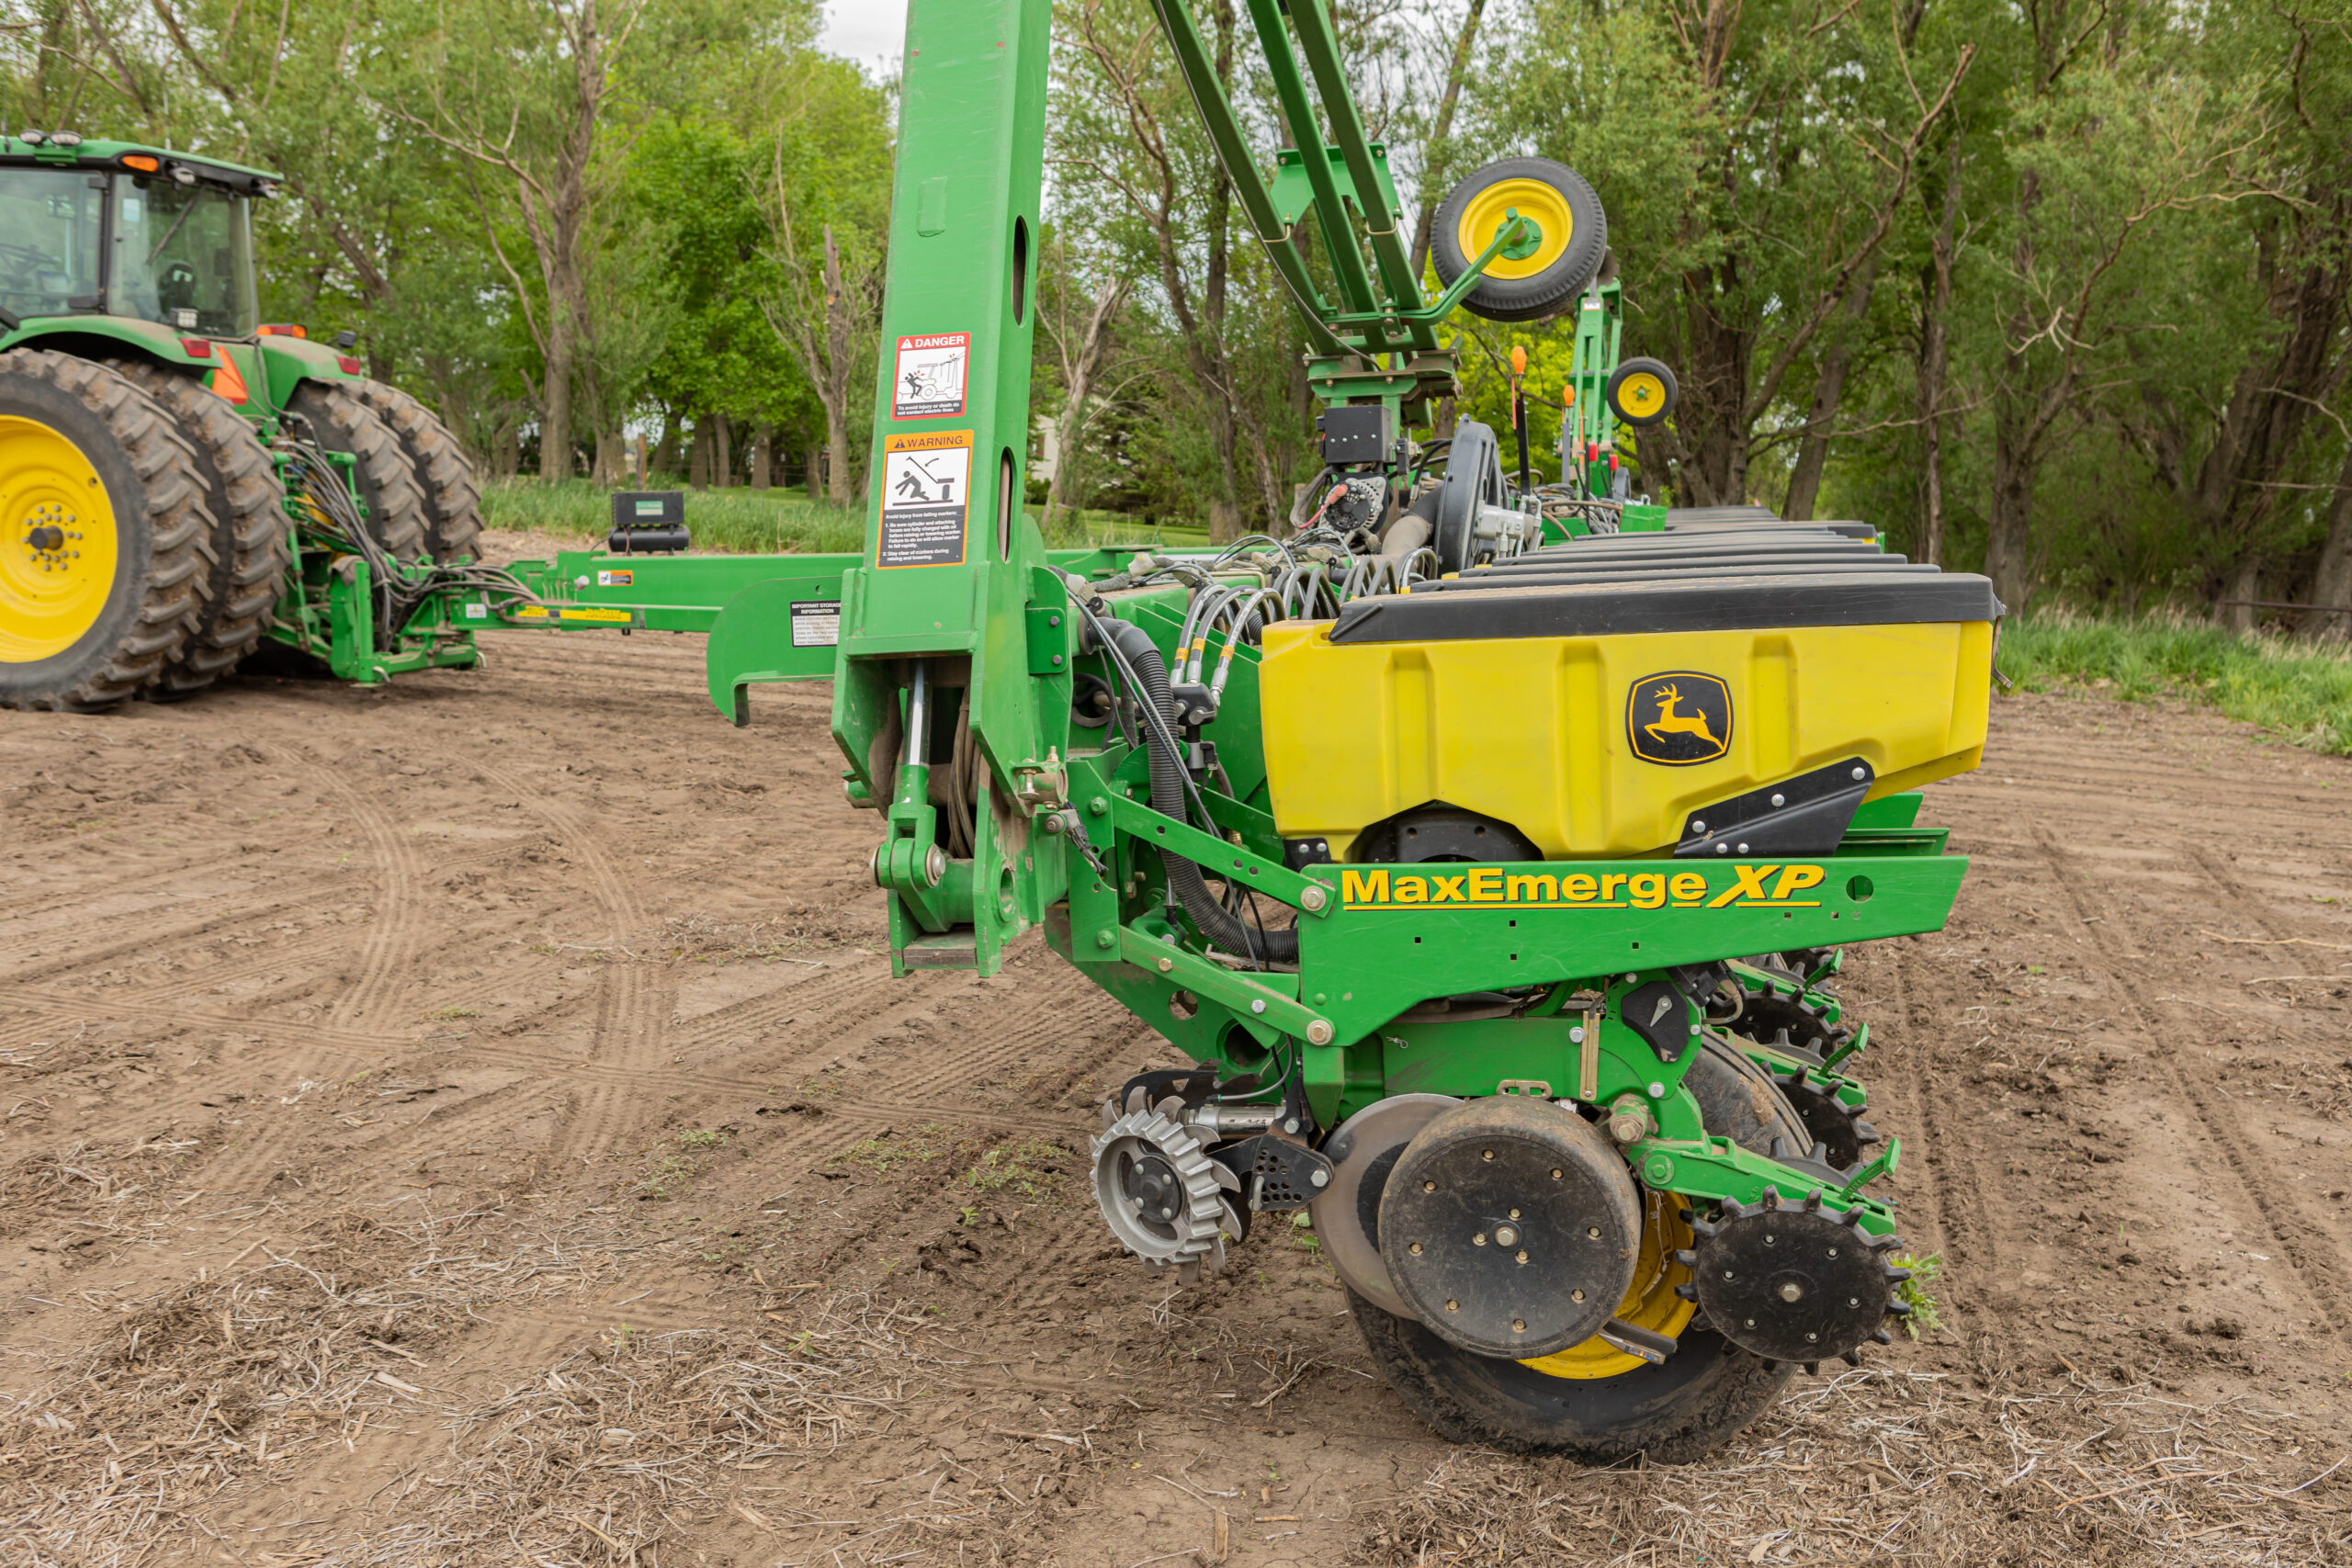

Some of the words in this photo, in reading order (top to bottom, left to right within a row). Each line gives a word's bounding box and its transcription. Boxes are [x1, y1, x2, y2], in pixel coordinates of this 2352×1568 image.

[915, 336, 964, 347] DANGER
[907, 435, 963, 448] WARNING
[1341, 867, 1709, 909] MaxEmerge
[1705, 864, 1826, 909] XP
